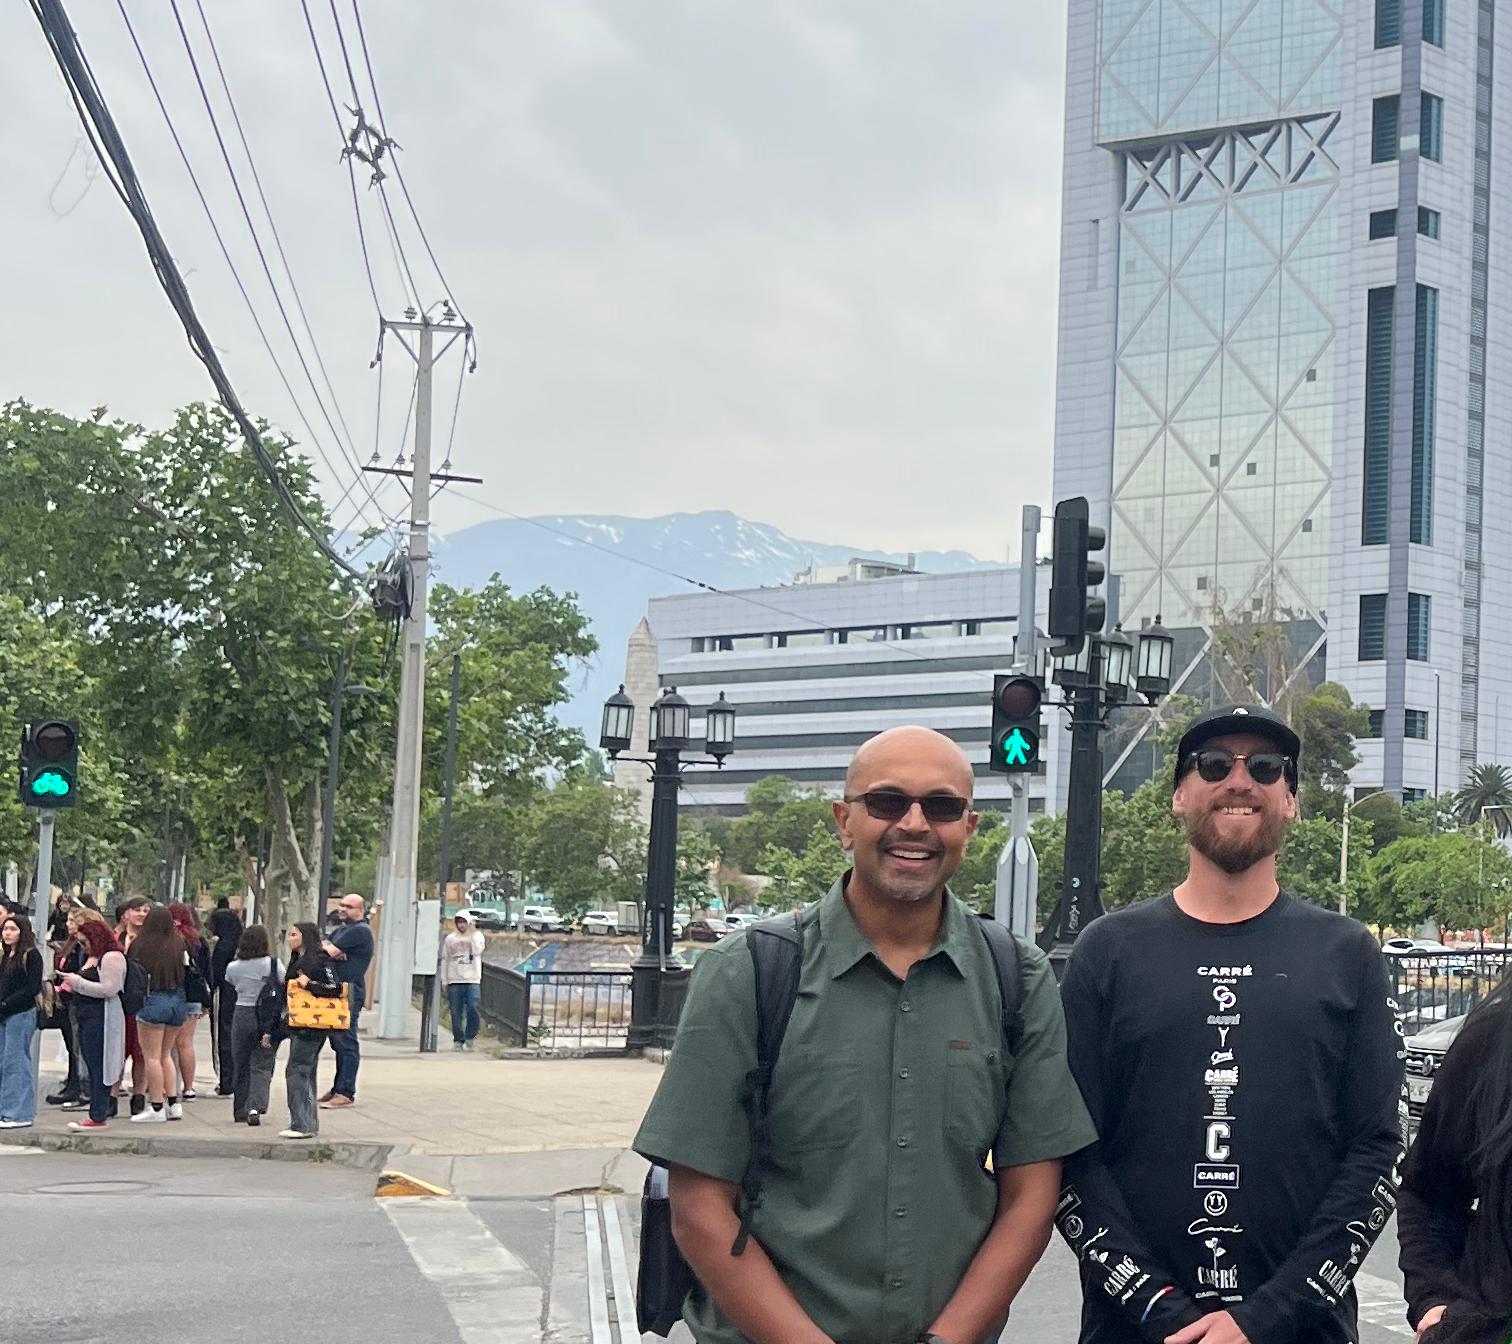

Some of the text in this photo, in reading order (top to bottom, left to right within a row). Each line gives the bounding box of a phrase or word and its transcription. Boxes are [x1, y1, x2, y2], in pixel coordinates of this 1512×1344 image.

[1197, 964, 1253, 977] CARRÉ
[1205, 1121, 1231, 1162] C
[1197, 1171, 1236, 1182] CARRÉ
